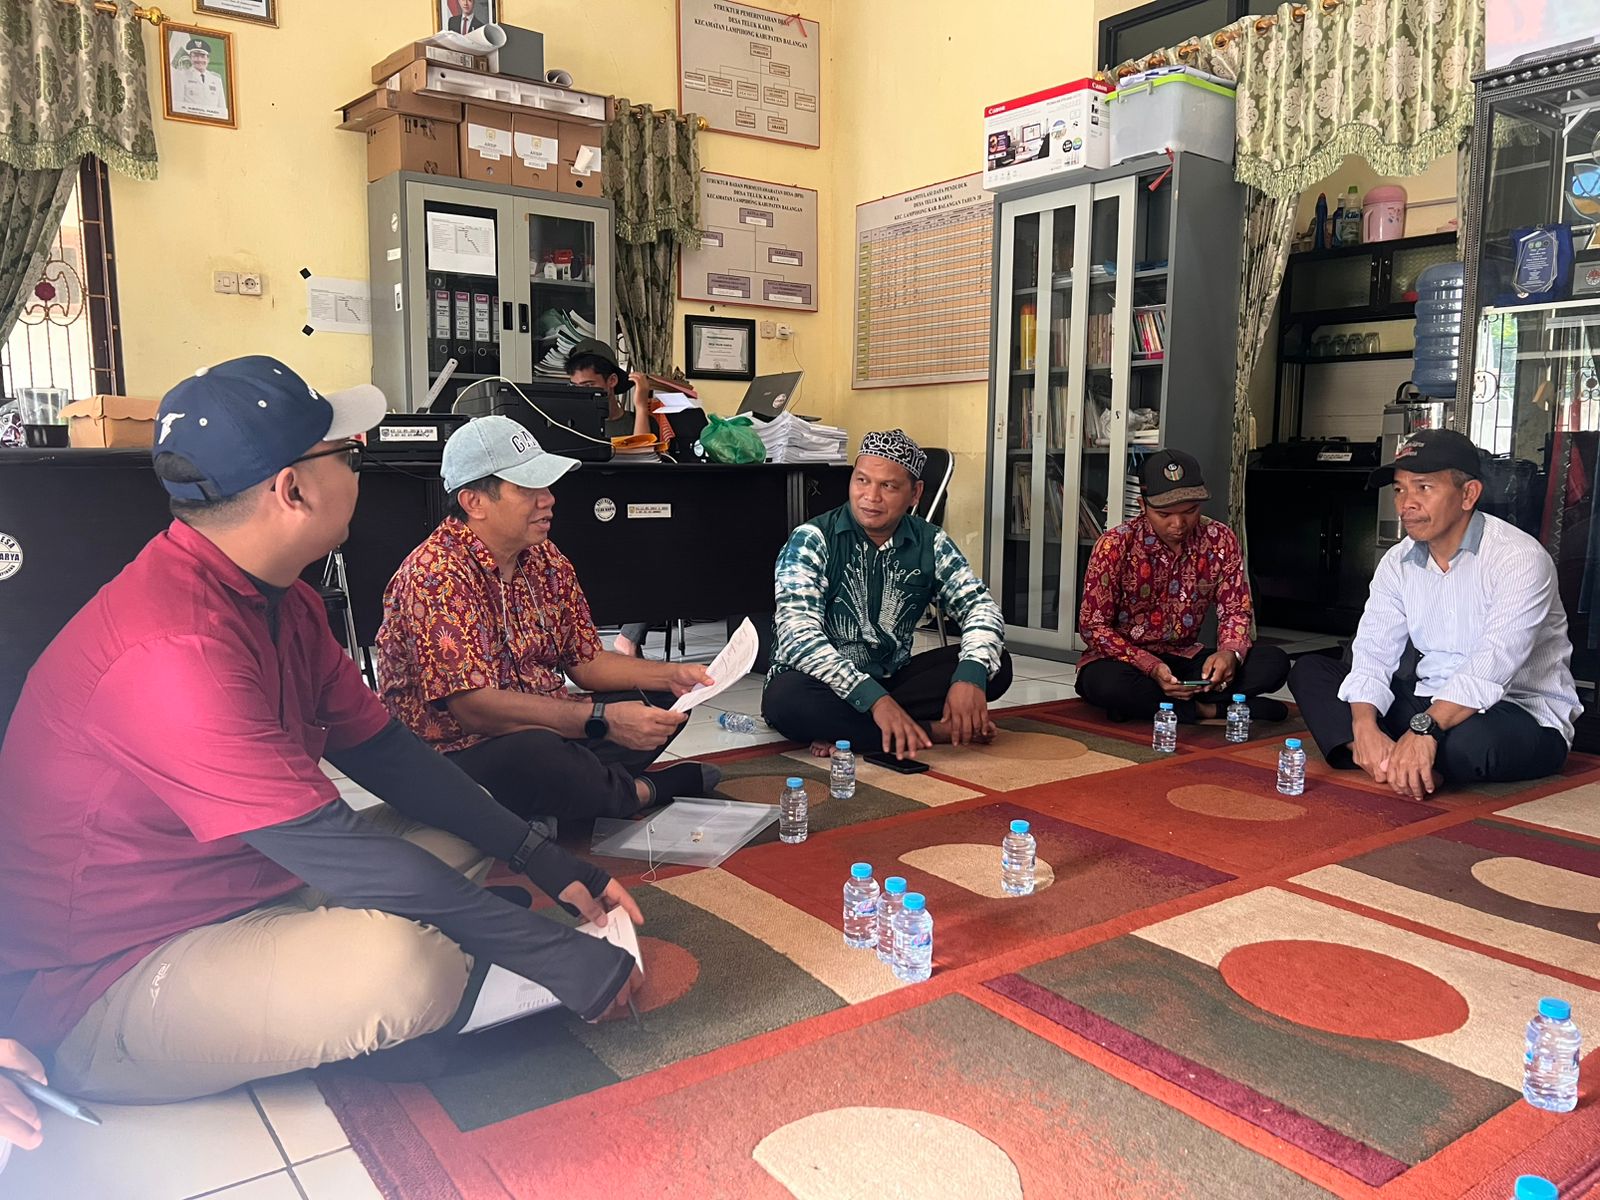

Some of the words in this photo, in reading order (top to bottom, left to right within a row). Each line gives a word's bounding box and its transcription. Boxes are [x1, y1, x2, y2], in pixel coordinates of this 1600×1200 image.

[714, 4, 739, 14] STRUKTUR
[740, 8, 777, 23] PEMERINTAHAN
[728, 16, 741, 24] DESA
[742, 20, 757, 28] TELUK
[758, 24, 774, 32] KARYA
[694, 18, 725, 31] KECAMATAN
[756, 31, 782, 43] KABUPATEN
[783, 37, 808, 48] BALANGAN
[1092, 82, 1108, 91] Canon
[988, 105, 1006, 115] Canon
[945, 182, 967, 192] PENDUDUK
[707, 193, 732, 202] KECAMATAN
[758, 200, 781, 209] KABUPATEN
[938, 200, 961, 210] BALANGAN
[1, 536, 15, 549] ESA
